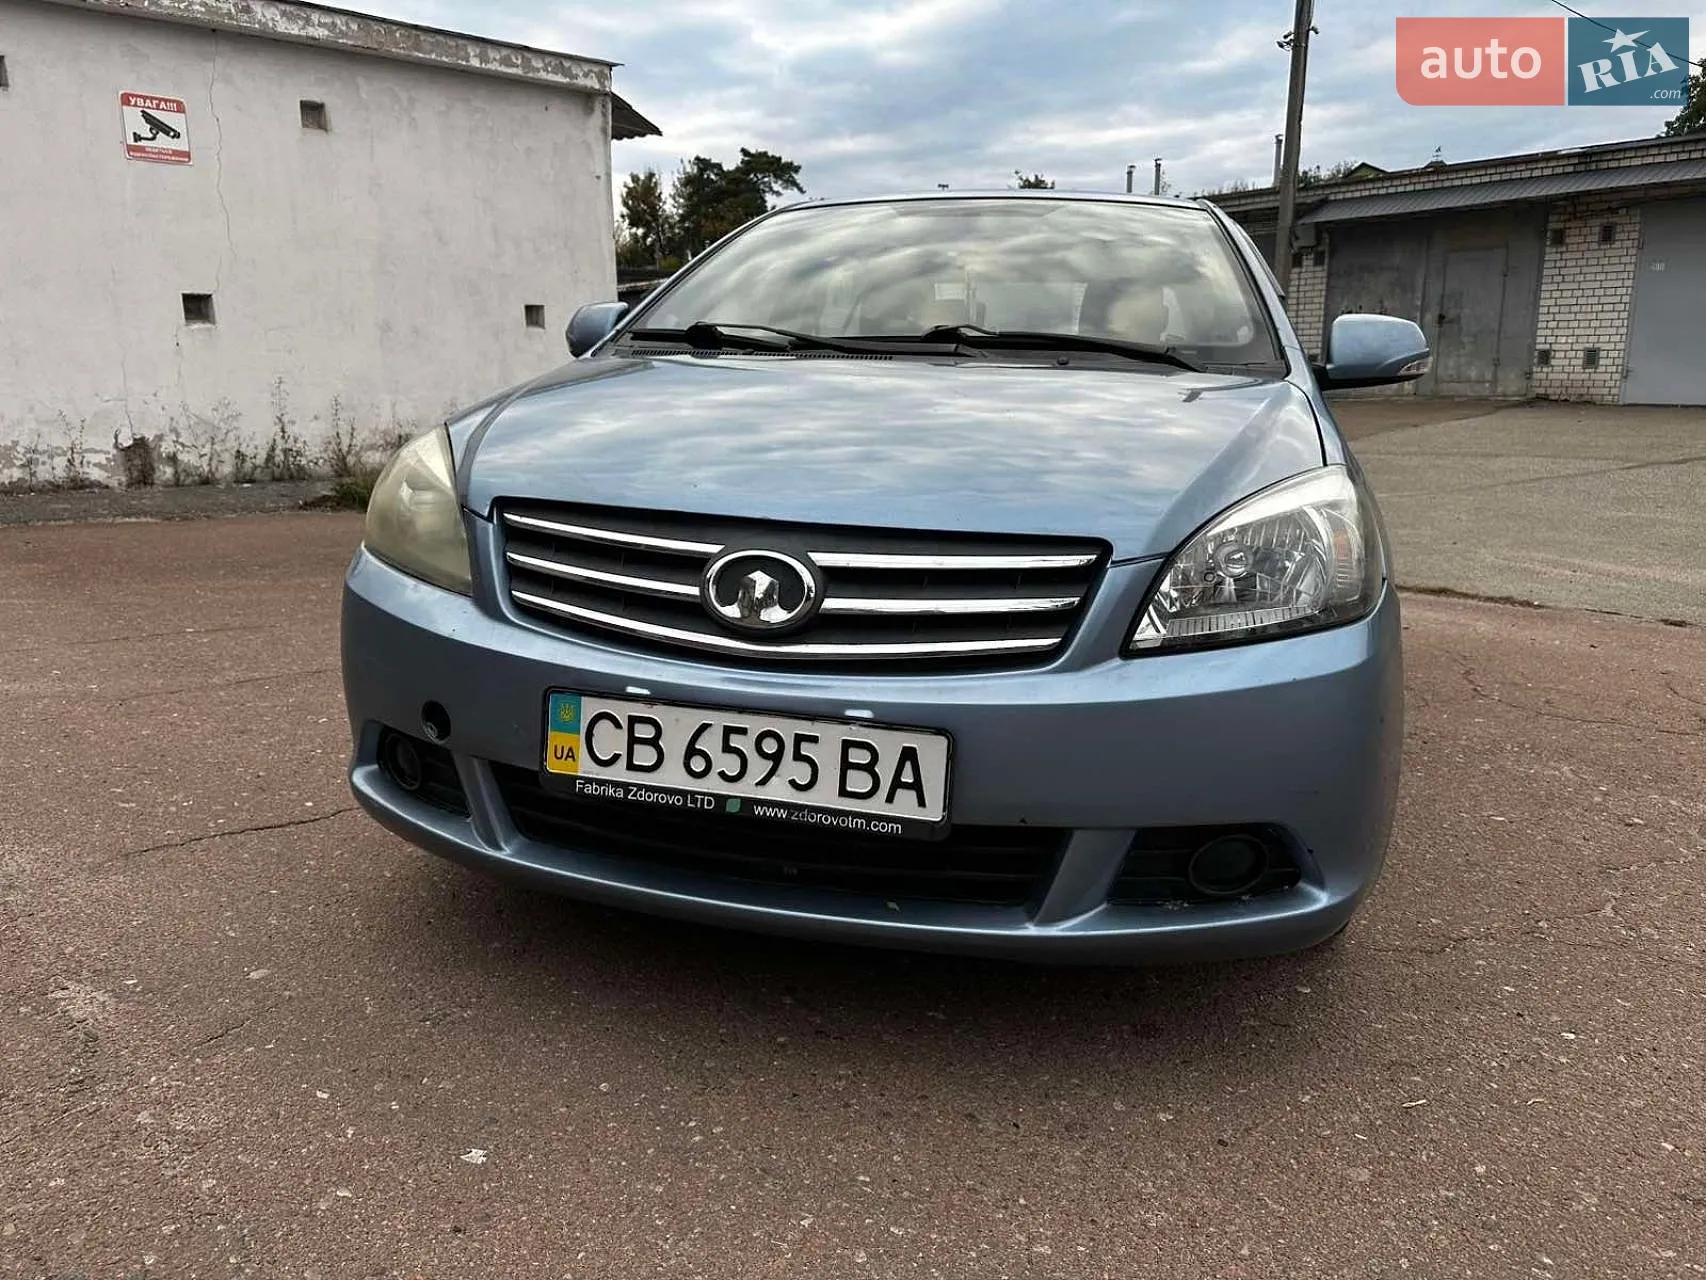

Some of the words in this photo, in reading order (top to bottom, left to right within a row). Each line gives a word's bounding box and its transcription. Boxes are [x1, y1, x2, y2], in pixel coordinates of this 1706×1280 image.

[128, 96, 177, 112] УВАГА!!!
[553, 744, 576, 762] UA
[584, 710, 665, 774] CB
[683, 722, 819, 792] 6595
[838, 738, 927, 808] BA
[575, 779, 625, 799] Fabrika
[627, 786, 684, 806] Zdorovo
[687, 794, 716, 810] LTD
[753, 804, 903, 835] wwwzdorovotm.com
